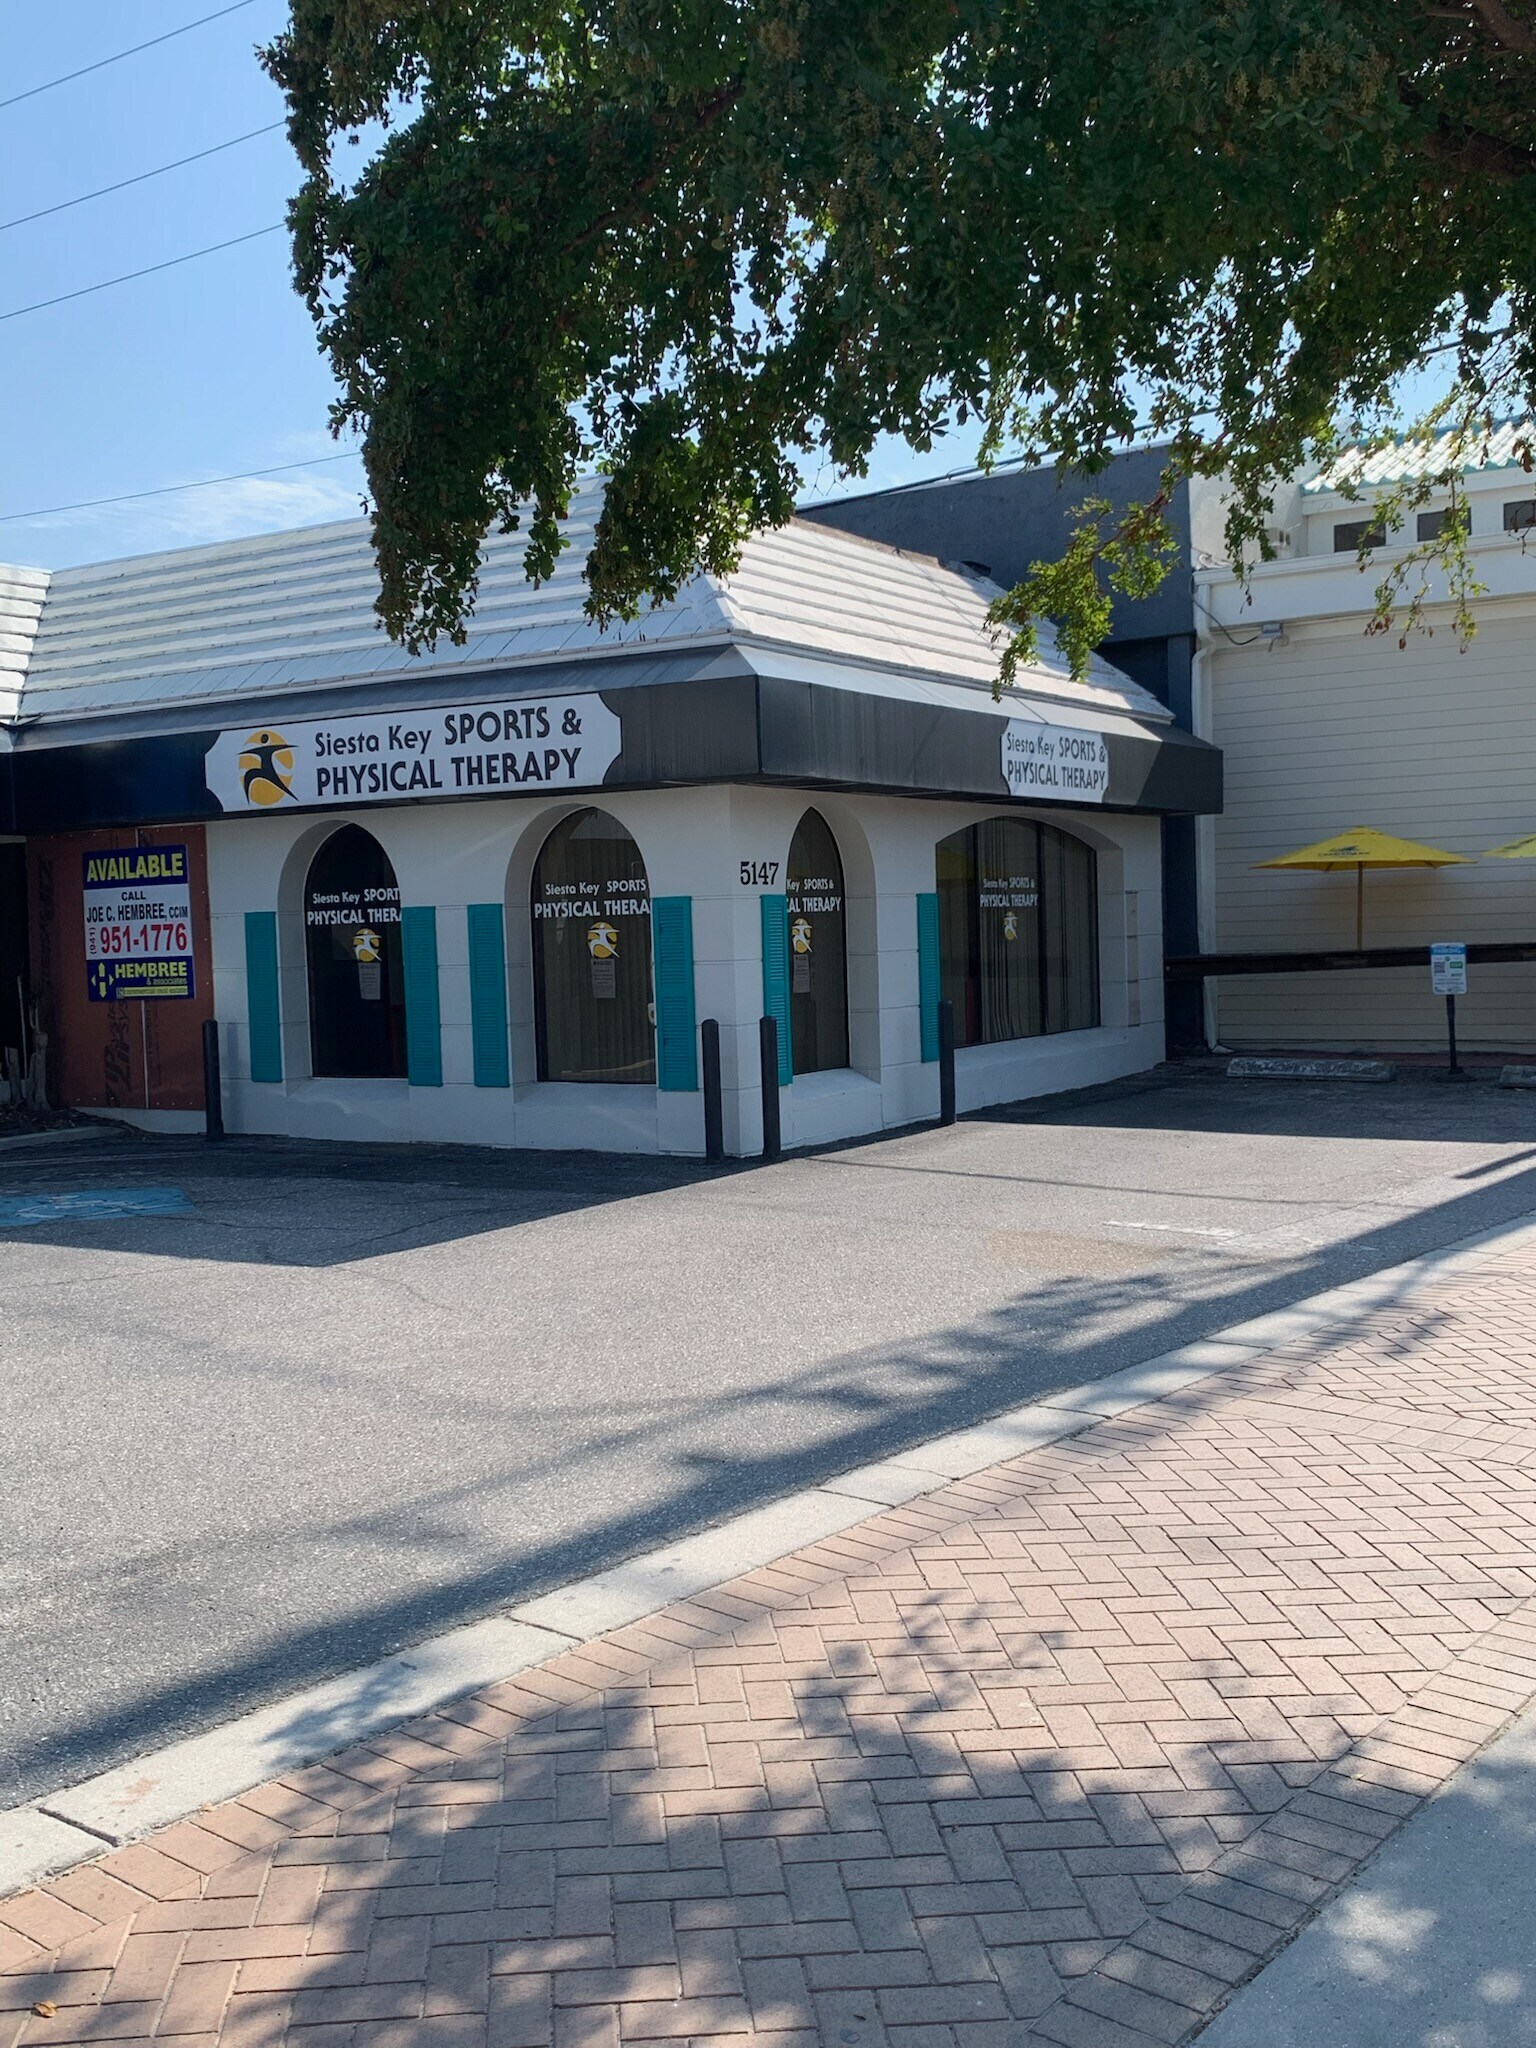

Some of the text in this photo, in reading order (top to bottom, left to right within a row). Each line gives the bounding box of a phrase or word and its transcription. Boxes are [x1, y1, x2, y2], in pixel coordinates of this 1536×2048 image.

[315, 706, 582, 757] Siesta Key SPORTS &
[1007, 732, 1106, 763] Siesta Key SPORTS &
[317, 747, 582, 797] PHYSICAL THERAPY
[1007, 759, 1106, 791] PHYSICAL THERAPY
[86, 852, 184, 883] AVAILABLE
[740, 861, 779, 886] 5147
[545, 878, 647, 897] Siesta Key SPORTS
[786, 878, 801, 893] Key
[803, 878, 828, 890] SPORTS
[121, 891, 146, 901] CALL
[312, 892, 340, 905] Siesta
[341, 891, 360, 905] Key
[802, 896, 841, 913] THERAPY
[980, 893, 1038, 907] PHYSICAL THERAPY
[86, 902, 188, 924] JOE C. HEMBREE, CCIM
[306, 907, 402, 926] PHYSICAL THER
[534, 900, 600, 919] PHYSICAL
[88, 922, 188, 955] (941) 951-1776
[114, 961, 188, 979] HEMBREE
